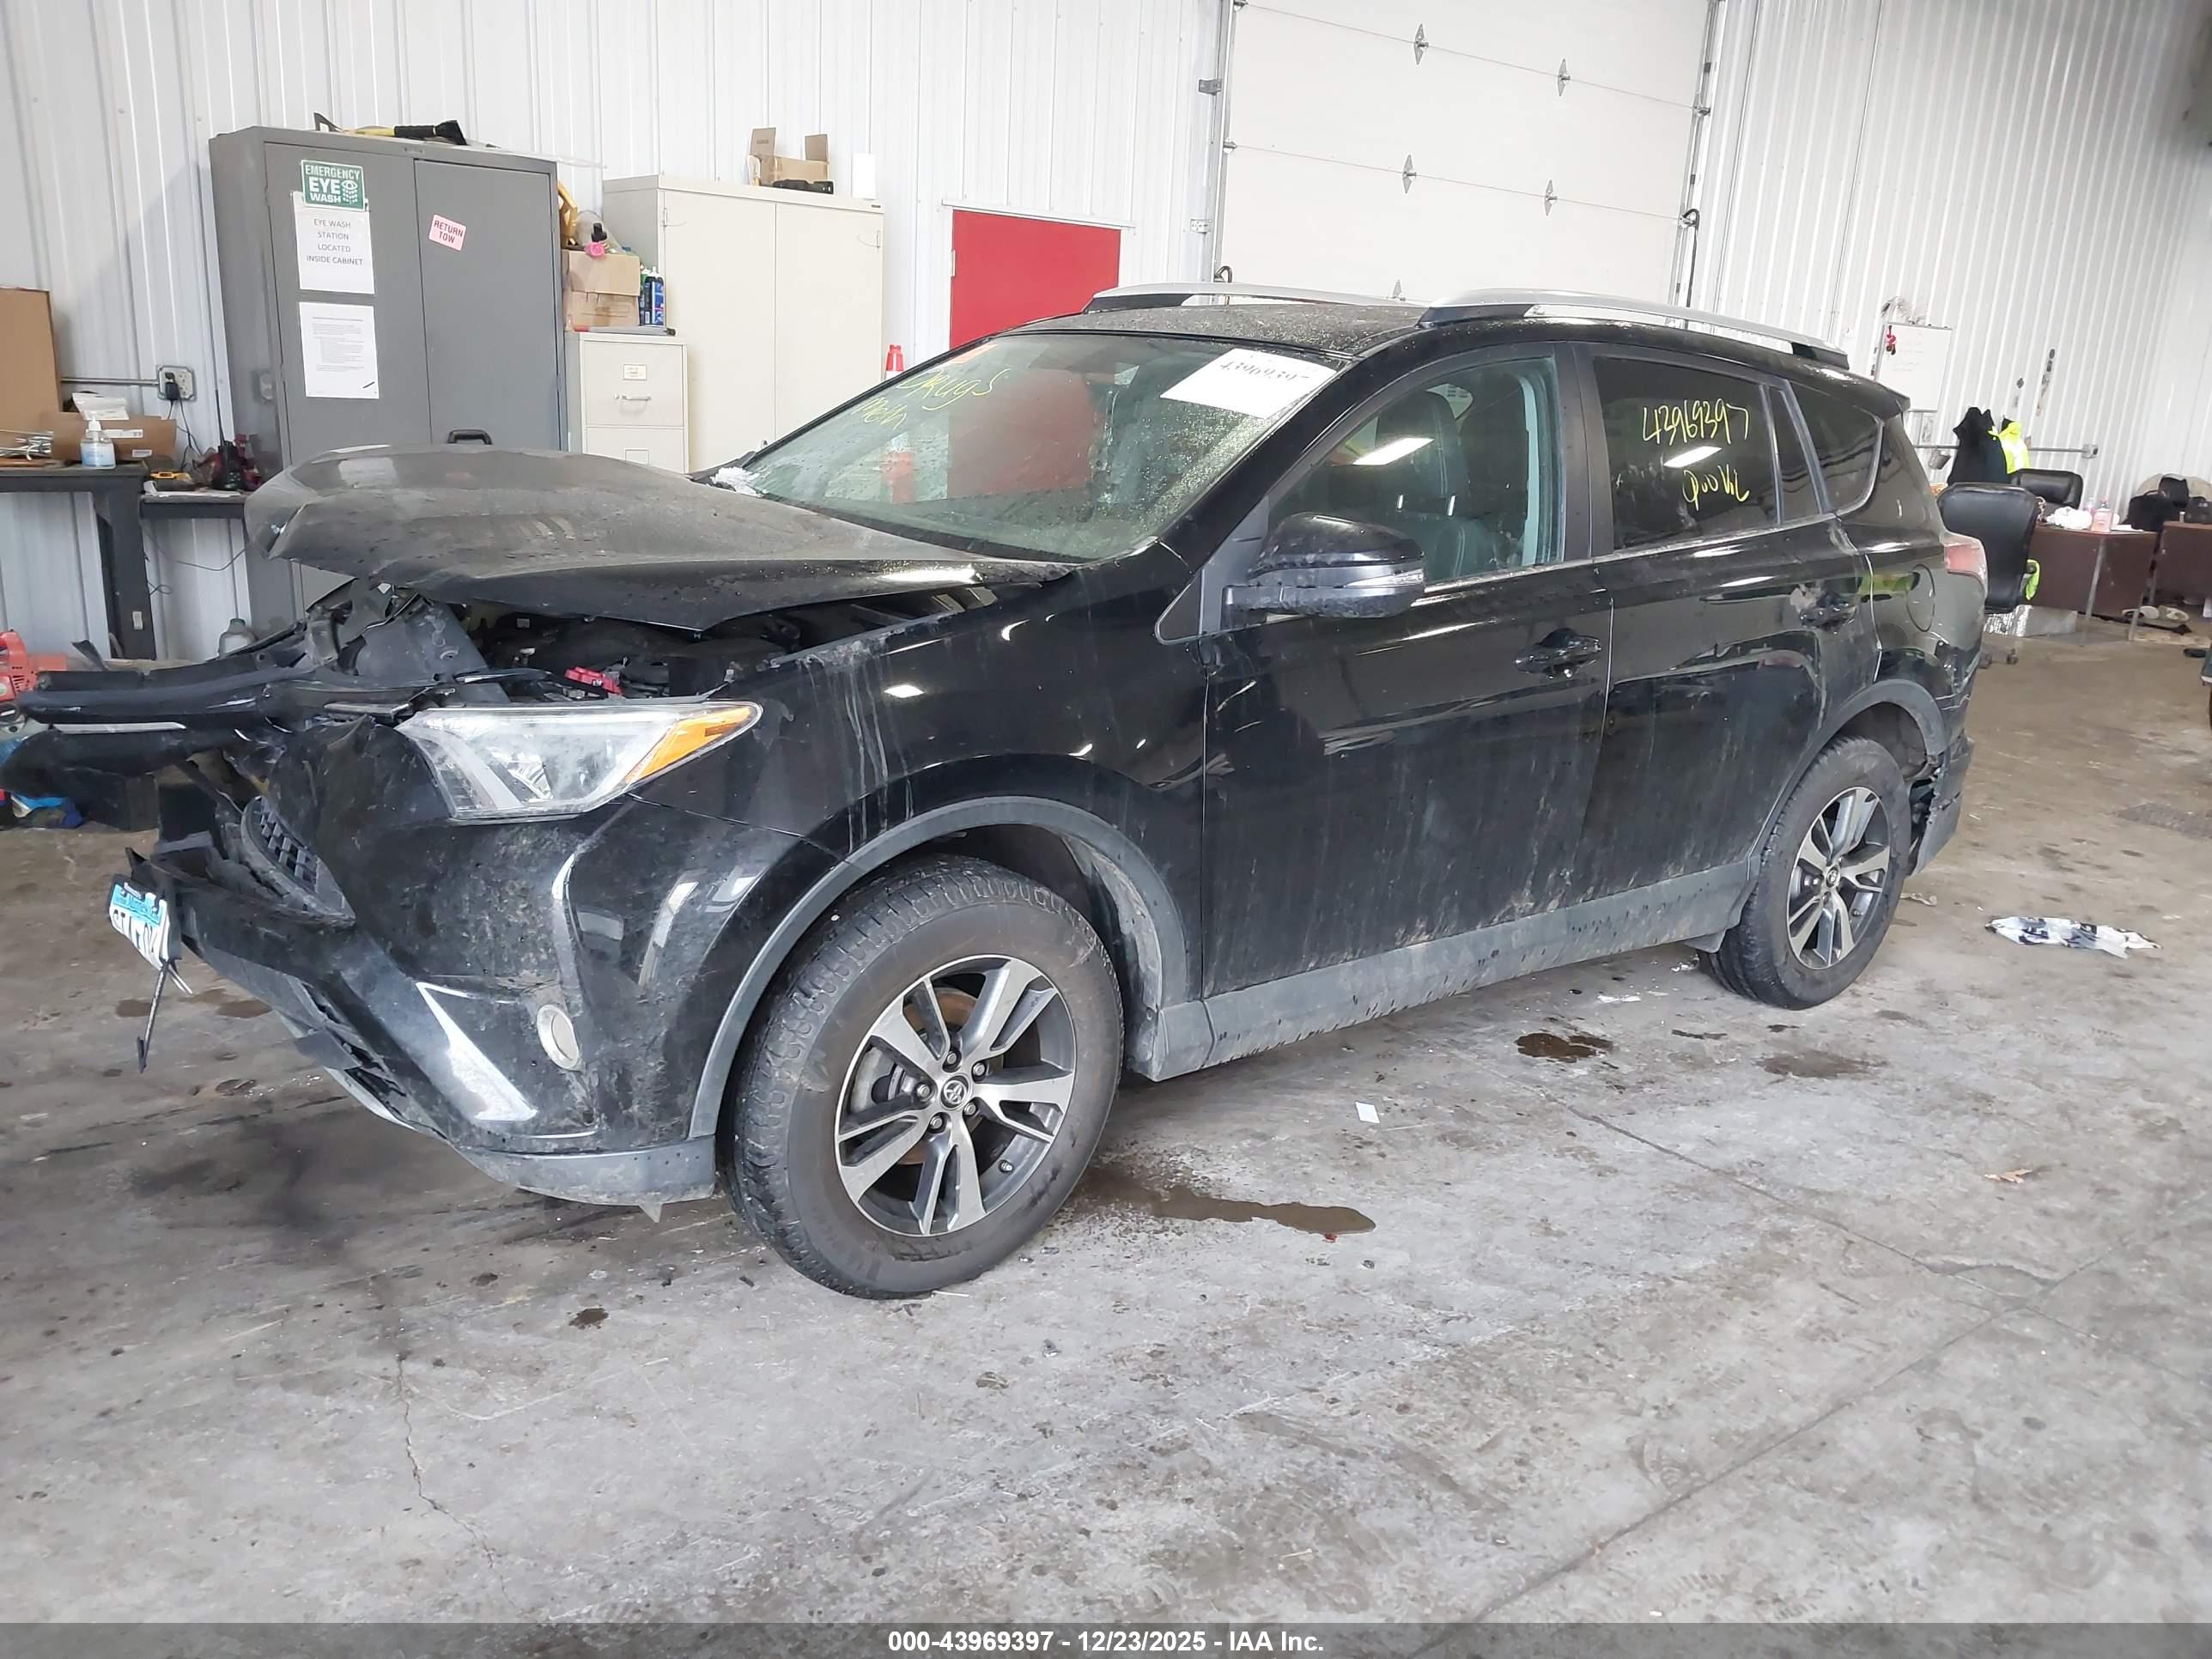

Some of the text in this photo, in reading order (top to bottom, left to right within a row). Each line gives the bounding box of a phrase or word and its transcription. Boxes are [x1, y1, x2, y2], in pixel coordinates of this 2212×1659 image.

[305, 164, 361, 180] EMERGENCY
[308, 176, 341, 195] EYE
[309, 191, 342, 204] WASH
[313, 218, 351, 228] EYE WASH
[434, 220, 464, 238] RETURN
[317, 231, 349, 240] STATION
[439, 230, 456, 244] TOW
[317, 243, 351, 252] LOCATED
[306, 254, 363, 266] INSIDE CABINET
[1642, 398, 1749, 447] 43969397
